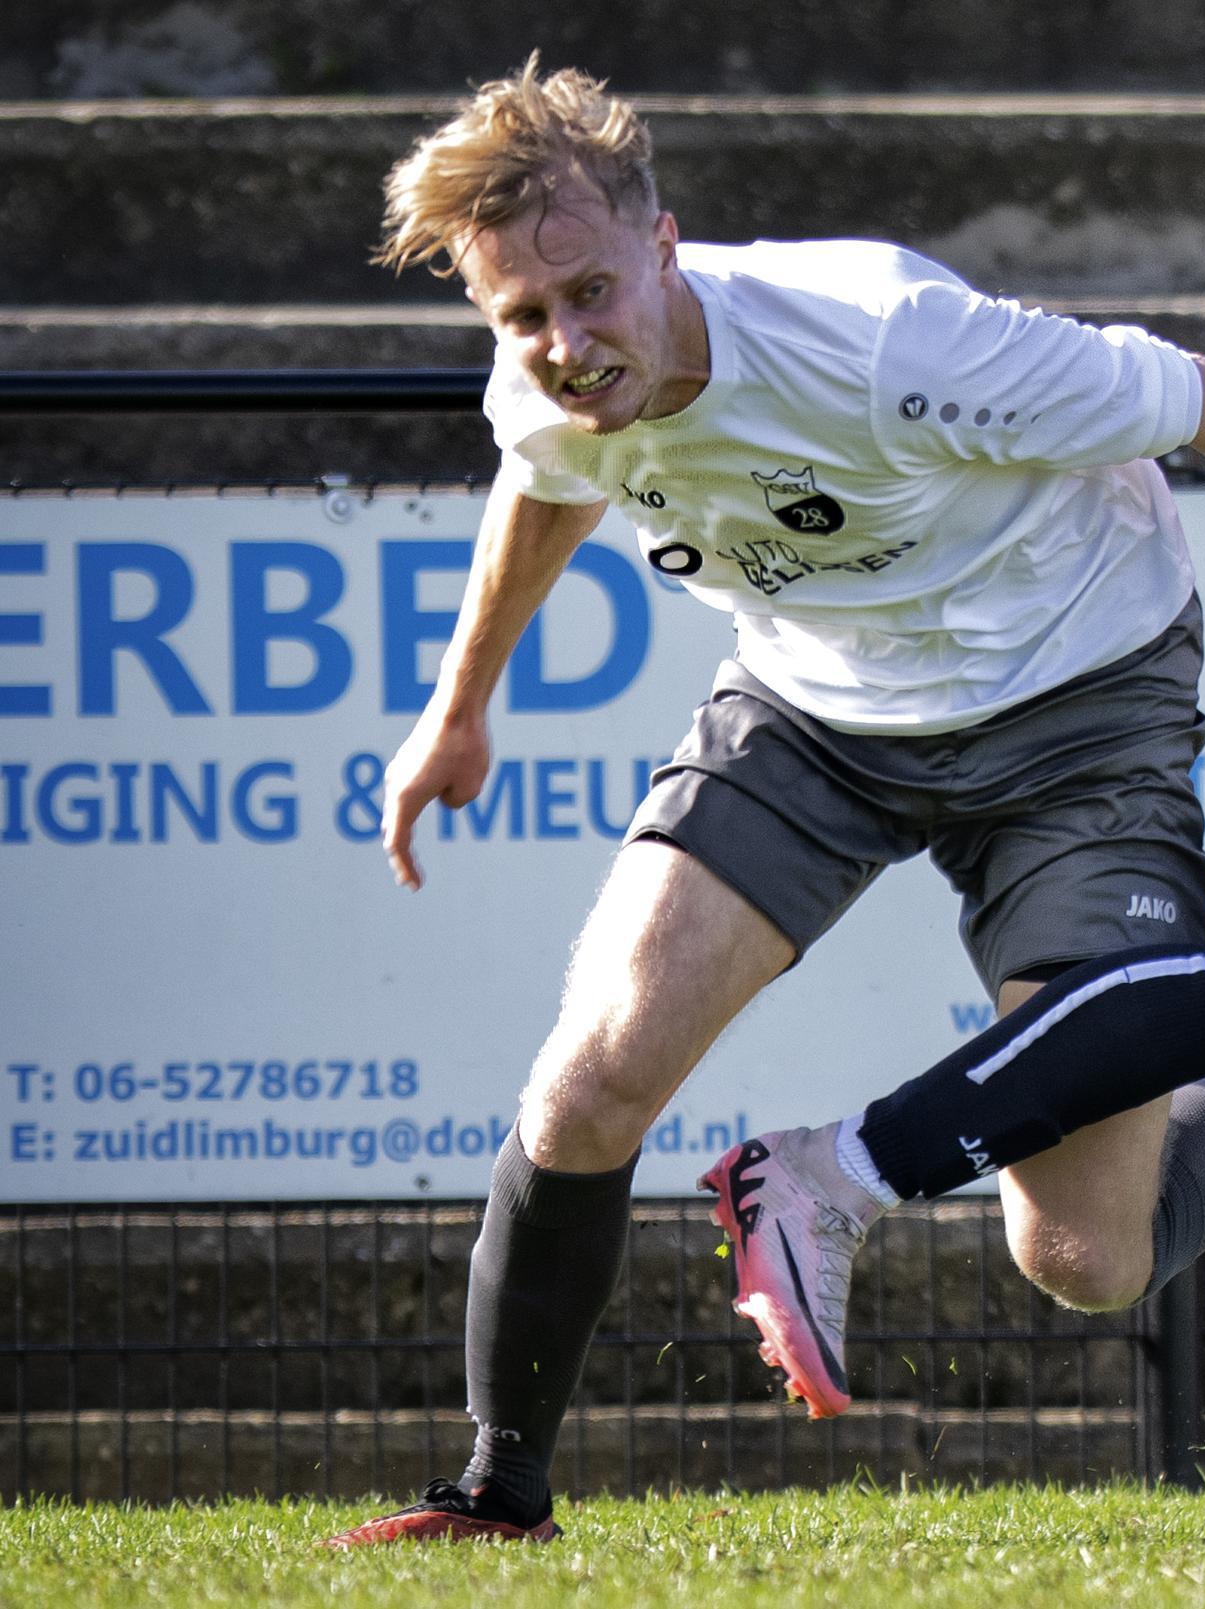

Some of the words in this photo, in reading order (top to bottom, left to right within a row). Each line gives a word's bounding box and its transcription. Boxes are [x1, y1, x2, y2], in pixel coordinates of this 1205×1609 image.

[791, 508, 829, 528] 28
[1126, 895, 1177, 925] JAKO
[7, 1062, 56, 1102] T:
[74, 1060, 421, 1102] 06-52786718
[10, 1121, 56, 1163] E:
[73, 1116, 748, 1169] zuidlimburg@dokd.nl
